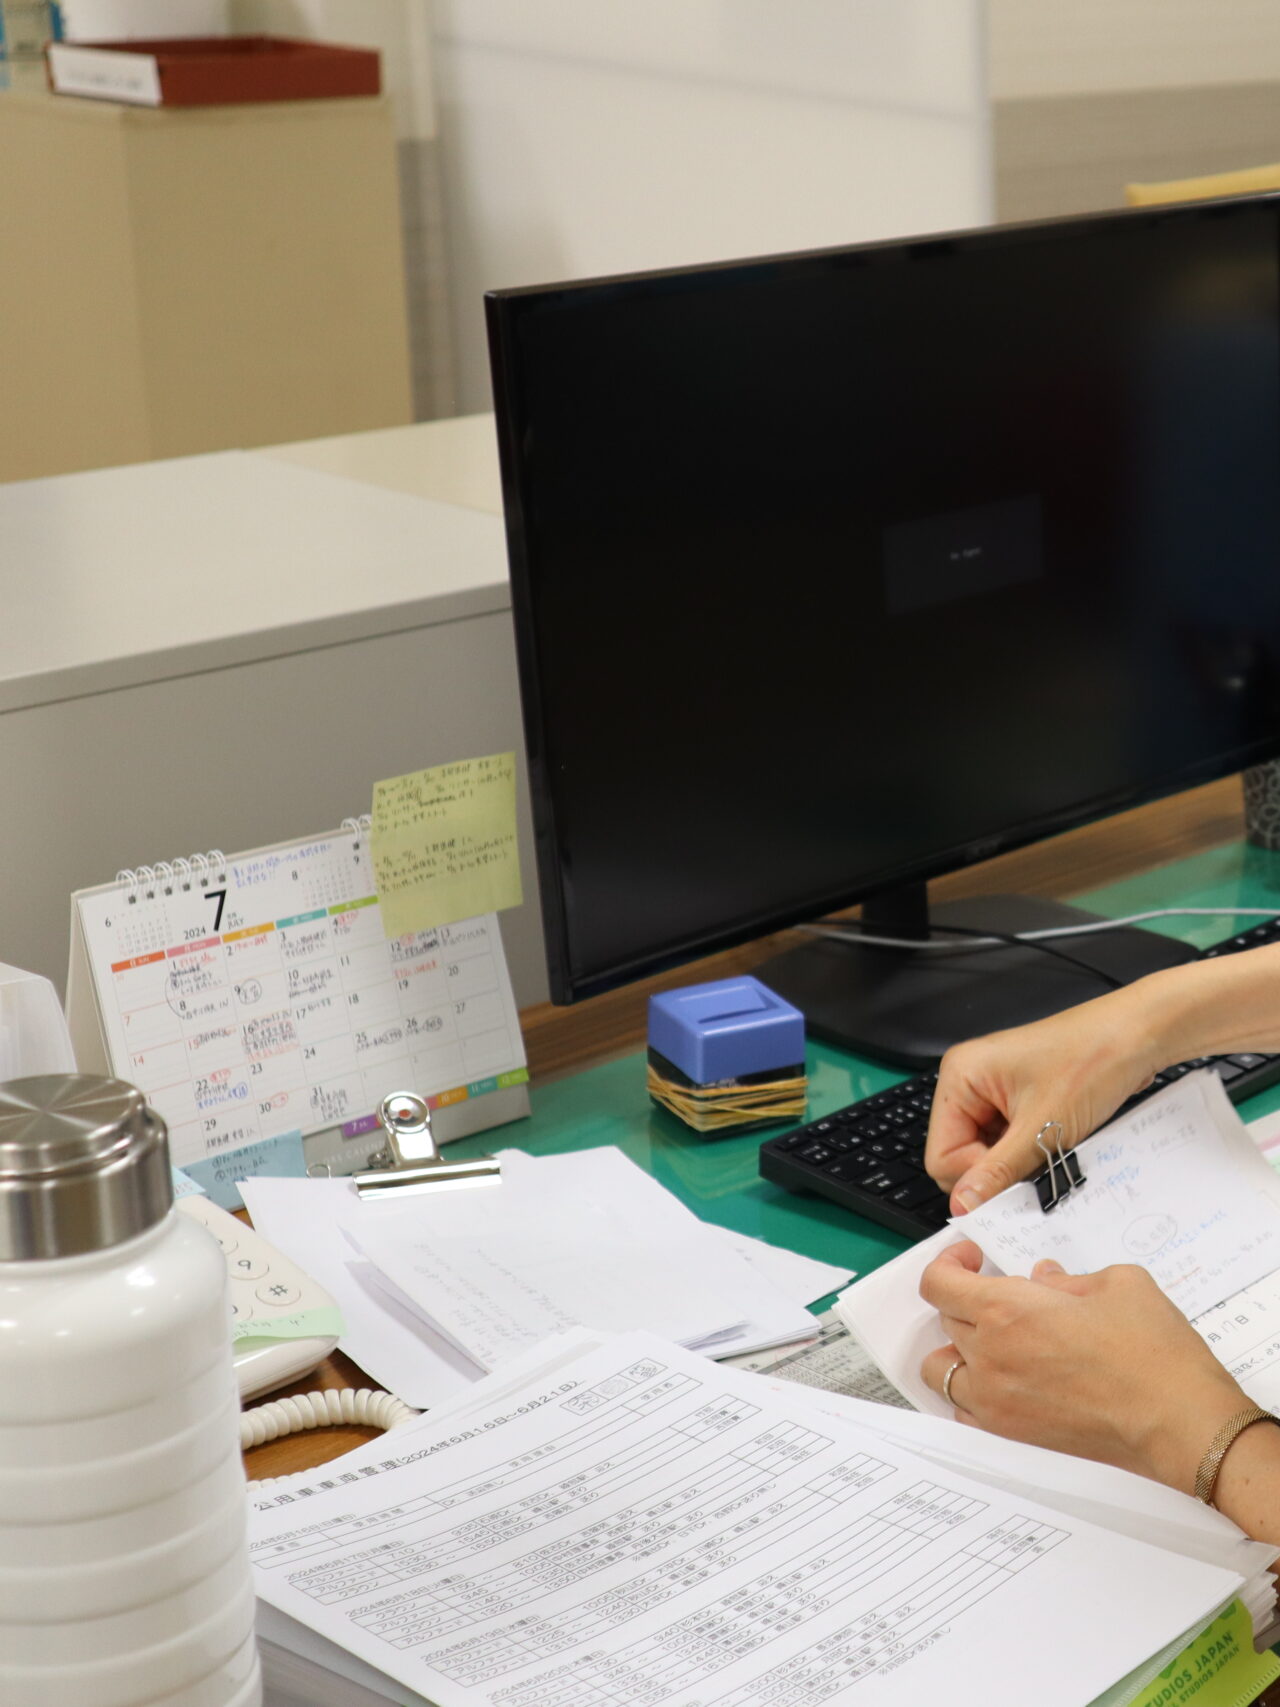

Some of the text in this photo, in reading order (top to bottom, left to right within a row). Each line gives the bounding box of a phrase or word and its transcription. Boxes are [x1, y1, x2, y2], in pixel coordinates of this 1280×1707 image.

[291, 872, 298, 881] 8
[204, 889, 227, 932] 7
[105, 918, 111, 927] 6
[228, 918, 244, 929] JULY
[332, 918, 338, 927] 4
[184, 928, 206, 940] 2024
[281, 931, 286, 940] 3
[227, 946, 233, 955] 2
[390, 942, 400, 951] 12
[340, 957, 350, 966] 11
[288, 970, 299, 980] 10
[448, 967, 458, 976] 20
[234, 986, 241, 995] 9
[398, 980, 409, 990] 19
[348, 994, 359, 1004] 18
[180, 1001, 186, 1011] 8
[455, 1003, 465, 1014] 27
[295, 1009, 306, 1020] 17
[124, 1016, 130, 1025] 7
[406, 1018, 417, 1028] 26
[356, 1033, 367, 1043] 25
[304, 1048, 316, 1059] 24
[133, 1056, 144, 1066] 14
[250, 1064, 263, 1074] 23
[196, 1080, 208, 1091] 22
[313, 1087, 323, 1097] 31
[259, 1103, 271, 1113] 30
[204, 1119, 217, 1131] 29
[352, 1121, 357, 1131] 7
[238, 1259, 251, 1271] 9
[269, 1285, 288, 1297] #
[1207, 1332, 1221, 1343] 月
[1235, 1314, 1249, 1326] 日
[245, 1512, 358, 1549] 24年6月16日(日曜日)
[301, 1563, 366, 1586] アルファード
[314, 1570, 378, 1593] アルファード
[336, 1580, 381, 1597] クラウン
[373, 1601, 418, 1618] クラウン
[376, 1605, 440, 1629] アルファード
[399, 1616, 444, 1633] クラウン
[401, 1619, 466, 1644] アルファード
[440, 1640, 503, 1667] アルファード
[1195, 1630, 1233, 1672] JAPAN
[454, 1648, 516, 1674] アルファード
[467, 1655, 530, 1682] アルファード
[1179, 1644, 1239, 1702] STUDIOS JAPAN
